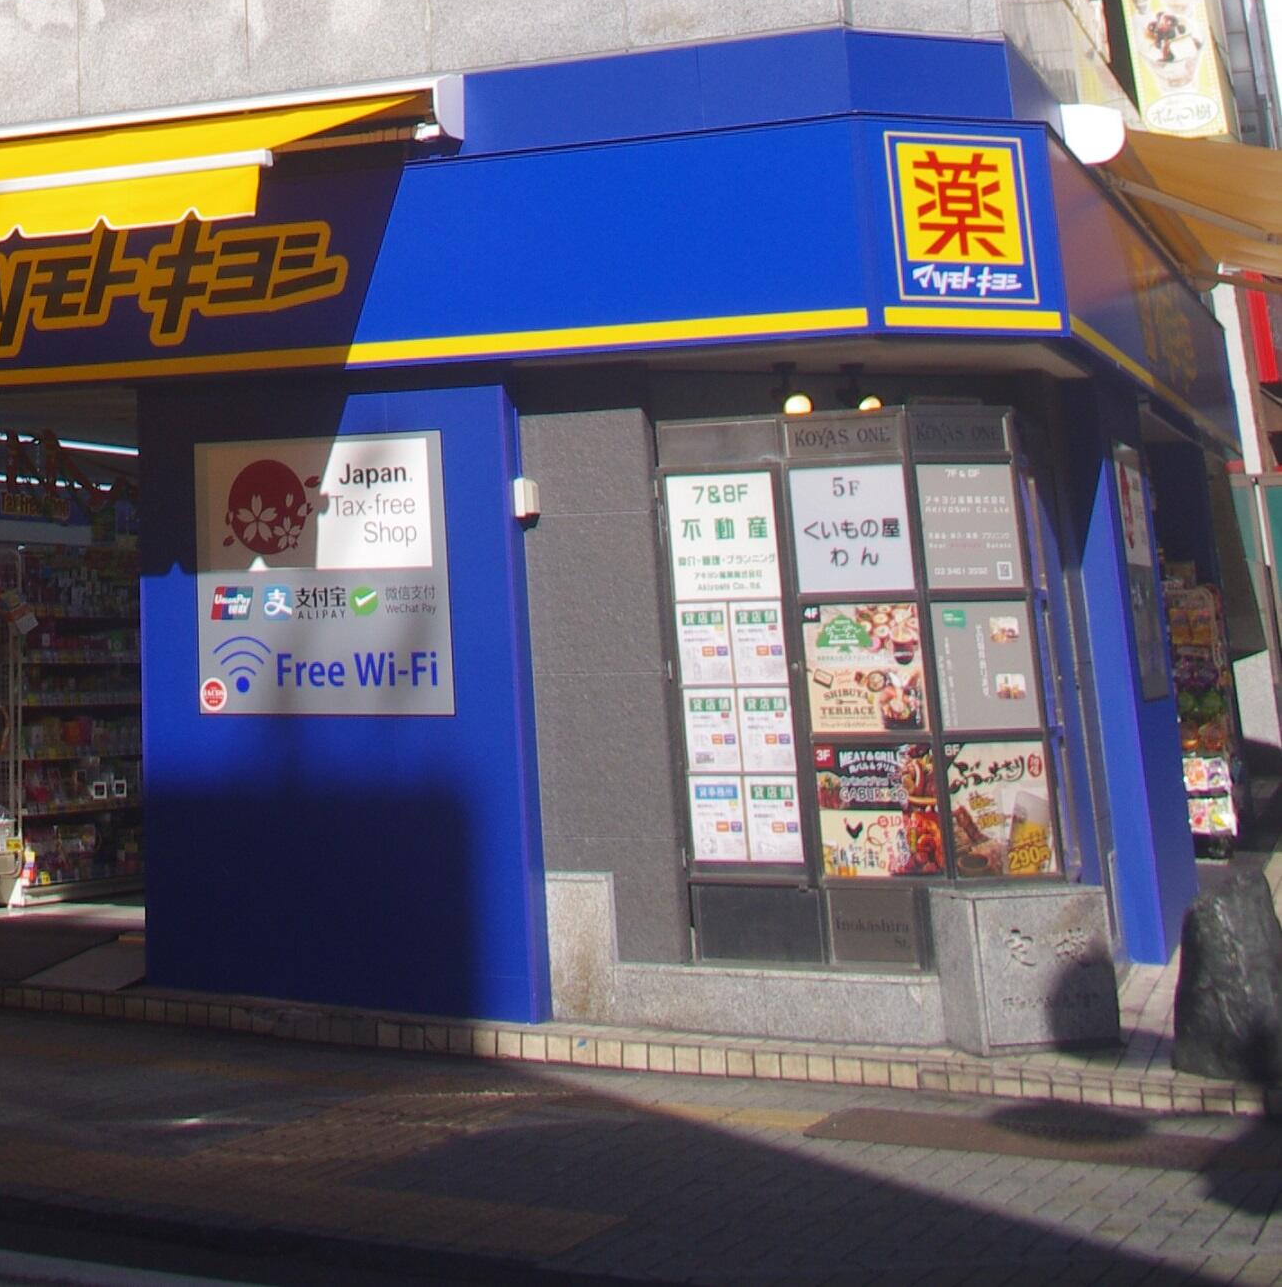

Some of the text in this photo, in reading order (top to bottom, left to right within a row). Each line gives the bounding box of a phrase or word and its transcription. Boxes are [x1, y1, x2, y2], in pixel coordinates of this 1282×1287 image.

[911, 150, 1007, 258] 薬
[911, 263, 1022, 297] マツモトキヨシ
[794, 426, 892, 449] KOYAS ONE
[691, 483, 749, 505] 7&8F
[831, 476, 861, 498] 5F
[330, 493, 416, 518] Tax-free
[363, 521, 417, 548] Shop
[680, 515, 769, 541] 不動産
[803, 517, 902, 541] くいもの屋
[830, 546, 880, 568] わん
[295, 586, 347, 609] 支付宝
[385, 585, 437, 602] 微信支付
[298, 609, 347, 620] ALIPAY
[385, 602, 419, 615] WeChat
[276, 650, 439, 688] Free Wi-Fi
[822, 688, 869, 700] SHIBUYA
[819, 706, 876, 717] TERRACE
[815, 748, 831, 762] 3F
